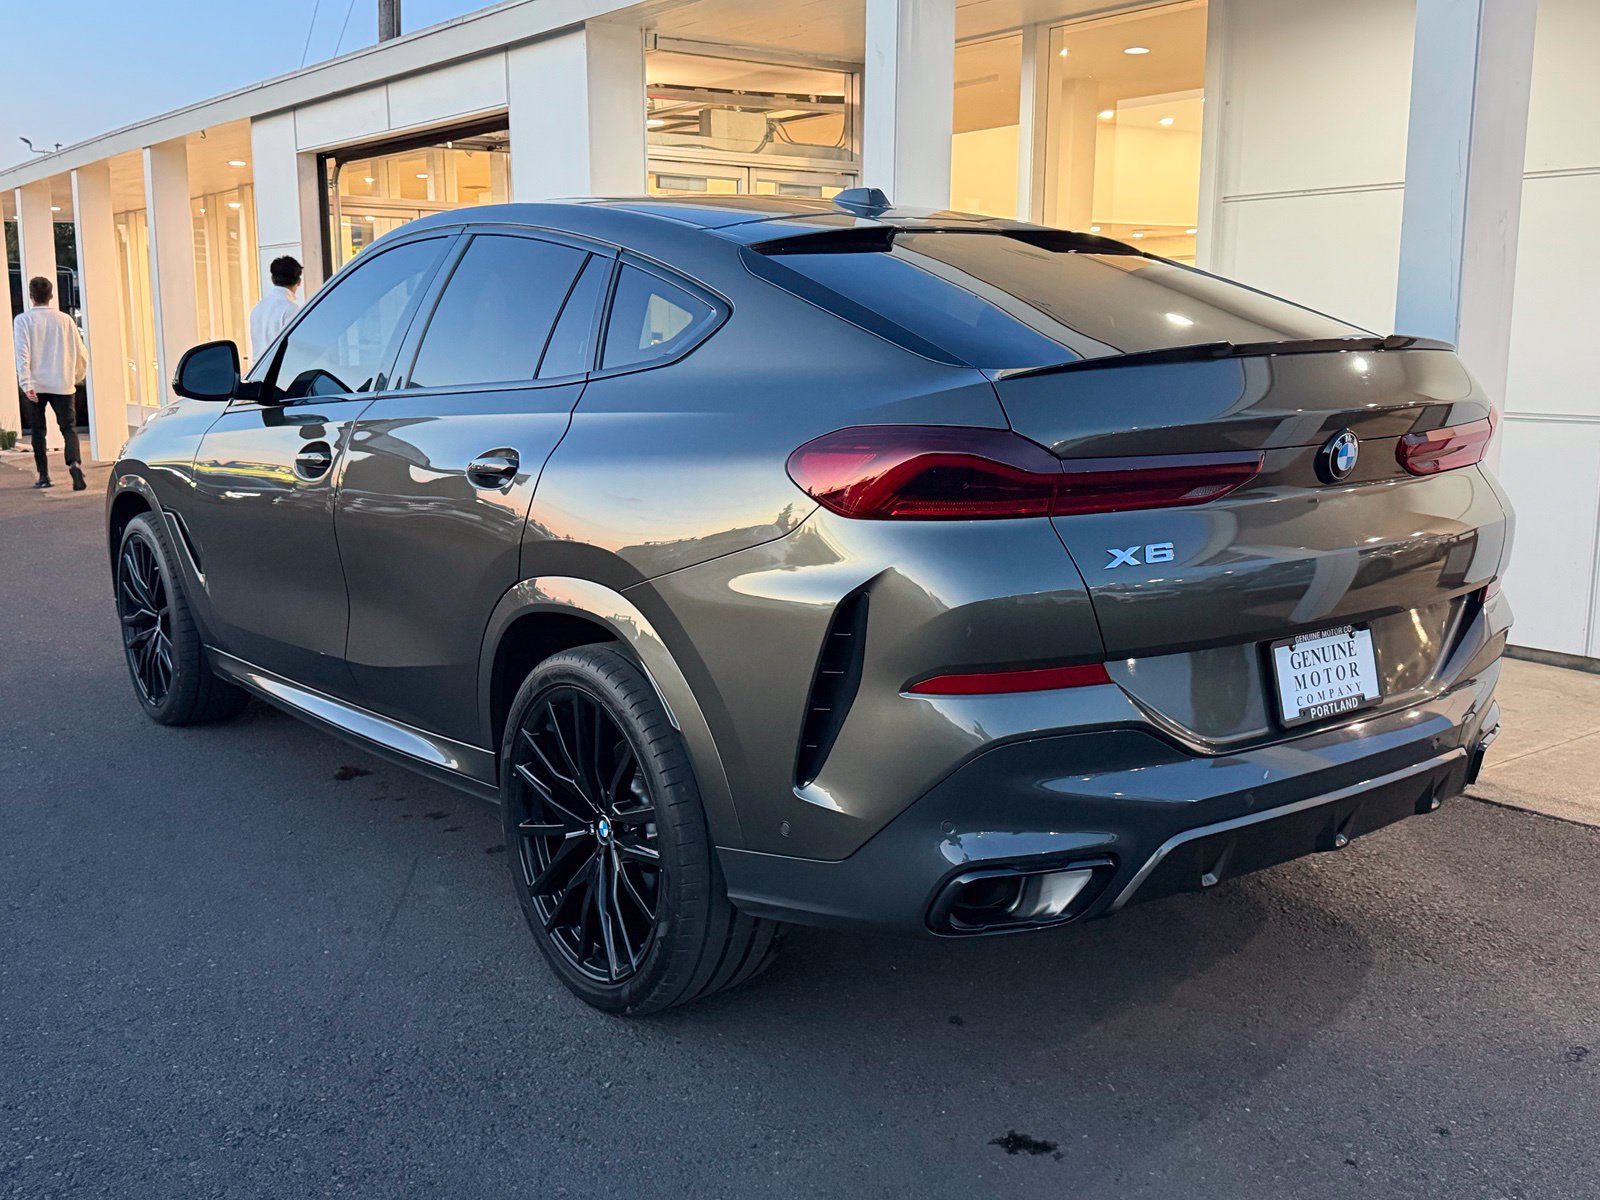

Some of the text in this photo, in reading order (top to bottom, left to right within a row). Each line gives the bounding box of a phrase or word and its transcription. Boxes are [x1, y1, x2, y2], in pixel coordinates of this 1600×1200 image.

[1103, 542, 1175, 570] X6
[1294, 631, 1321, 644] GENUINE
[1321, 626, 1343, 638] MOTOR
[1290, 640, 1357, 670] GENUINE
[1293, 661, 1360, 692] MOTOR
[1296, 681, 1362, 707] COMPANY
[1310, 697, 1359, 719] PORTLAND
